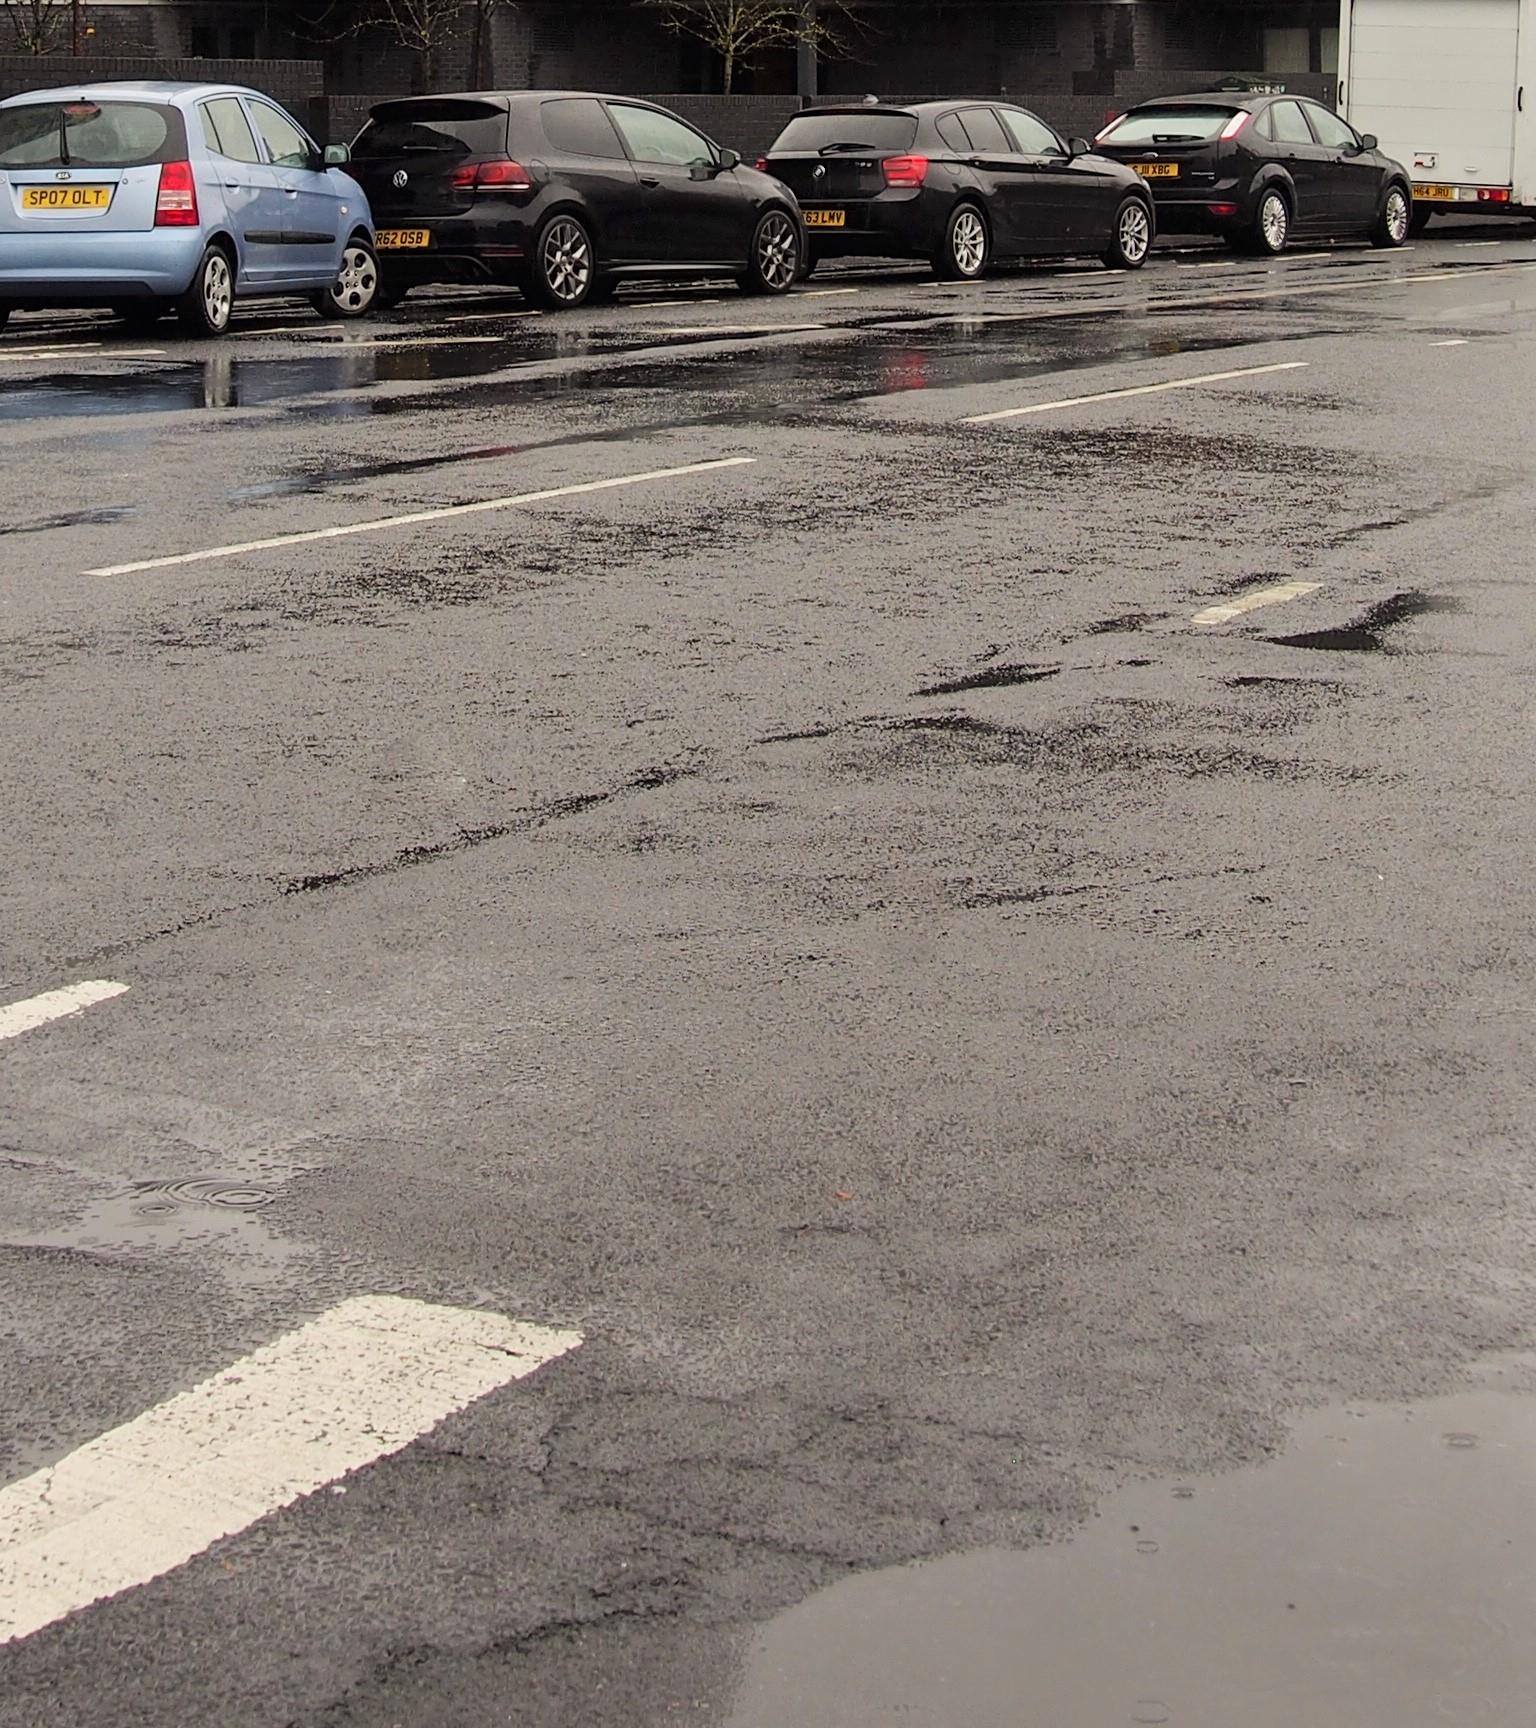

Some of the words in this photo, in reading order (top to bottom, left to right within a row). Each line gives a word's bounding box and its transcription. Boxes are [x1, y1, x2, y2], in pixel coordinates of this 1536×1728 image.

[30, 191, 68, 205] SP07
[72, 190, 103, 204] OLT
[822, 212, 843, 223] LMV
[375, 232, 398, 245] R62
[400, 232, 423, 245] OSB
